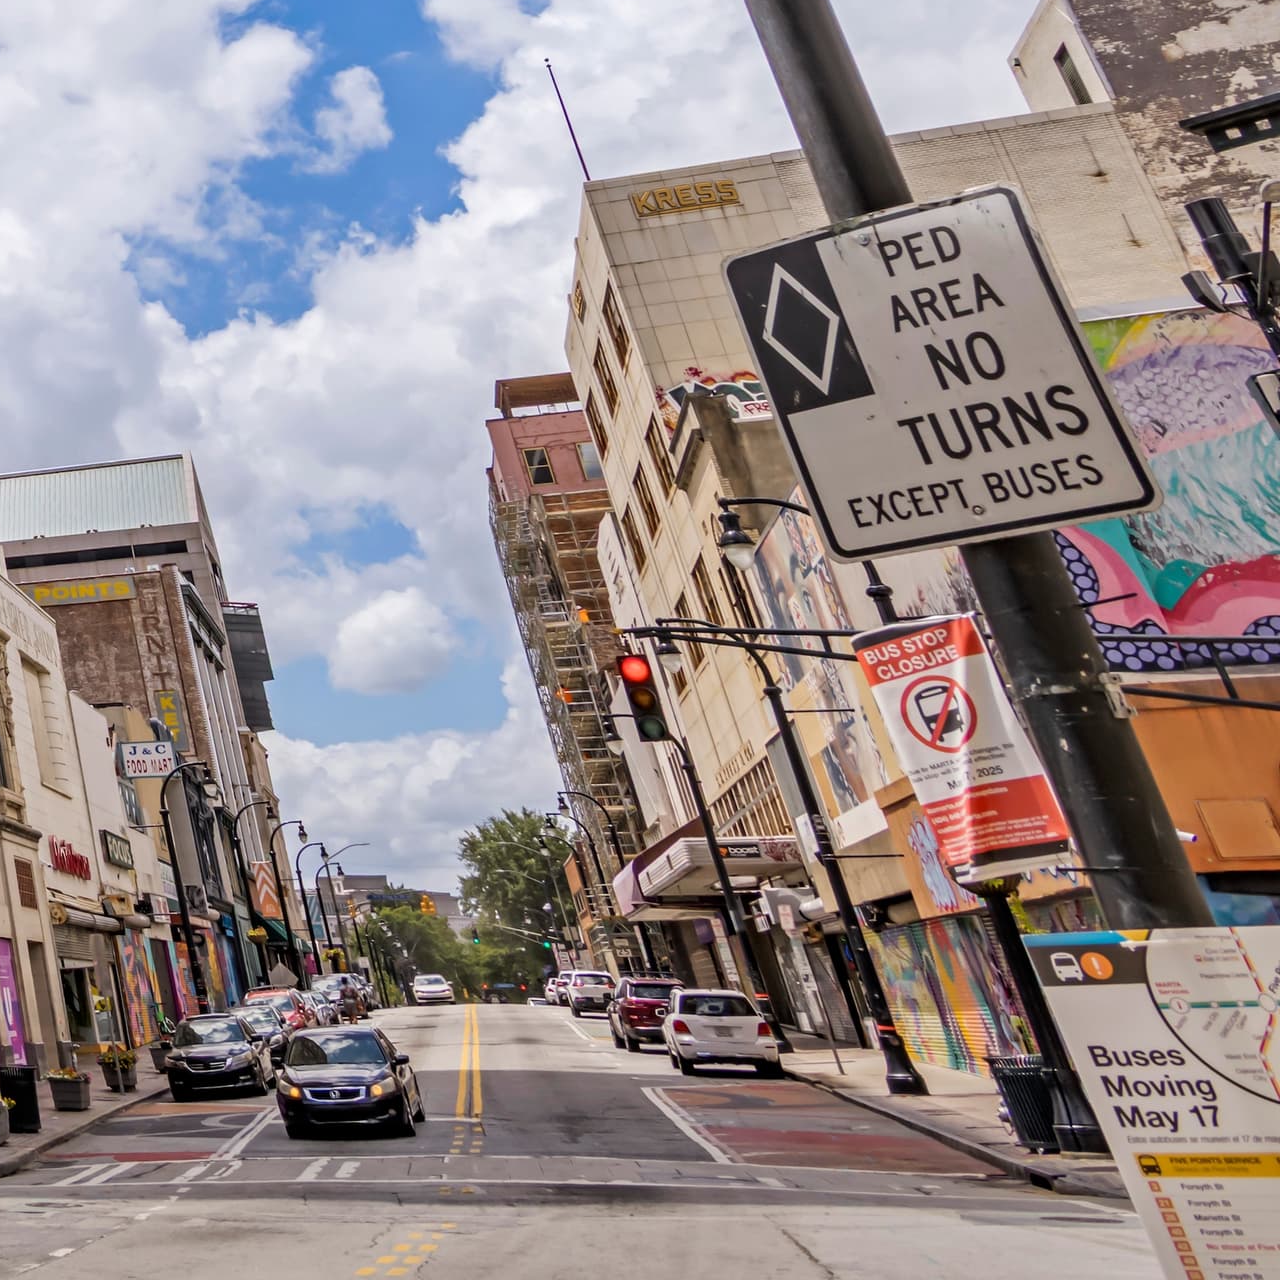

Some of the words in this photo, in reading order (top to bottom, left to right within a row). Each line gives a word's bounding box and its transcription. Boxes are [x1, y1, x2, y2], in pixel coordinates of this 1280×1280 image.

[631, 180, 739, 215] KRESS
[877, 225, 961, 277] PED
[890, 273, 1005, 333] AREA
[924, 331, 1005, 390] NO
[898, 385, 1089, 465] TURNS
[847, 478, 971, 529] EXCEPT
[982, 454, 1104, 504] BUSES
[34, 581, 131, 601] POINTS
[863, 642, 902, 665] BUS
[903, 628, 948, 653] STOP
[877, 645, 960, 680] CLOSURE
[128, 745, 137, 756] J
[142, 747, 152, 755] &
[156, 744, 167, 754] C
[126, 759, 148, 774] FOOD
[976, 764, 1004, 778] 2025
[107, 835, 133, 866] FOCUS
[728, 846, 760, 854] boost
[1088, 1045, 1186, 1068] Buses
[1100, 1074, 1217, 1101] Moving
[1114, 1105, 1179, 1133] May
[1189, 1105, 1219, 1127] 17
